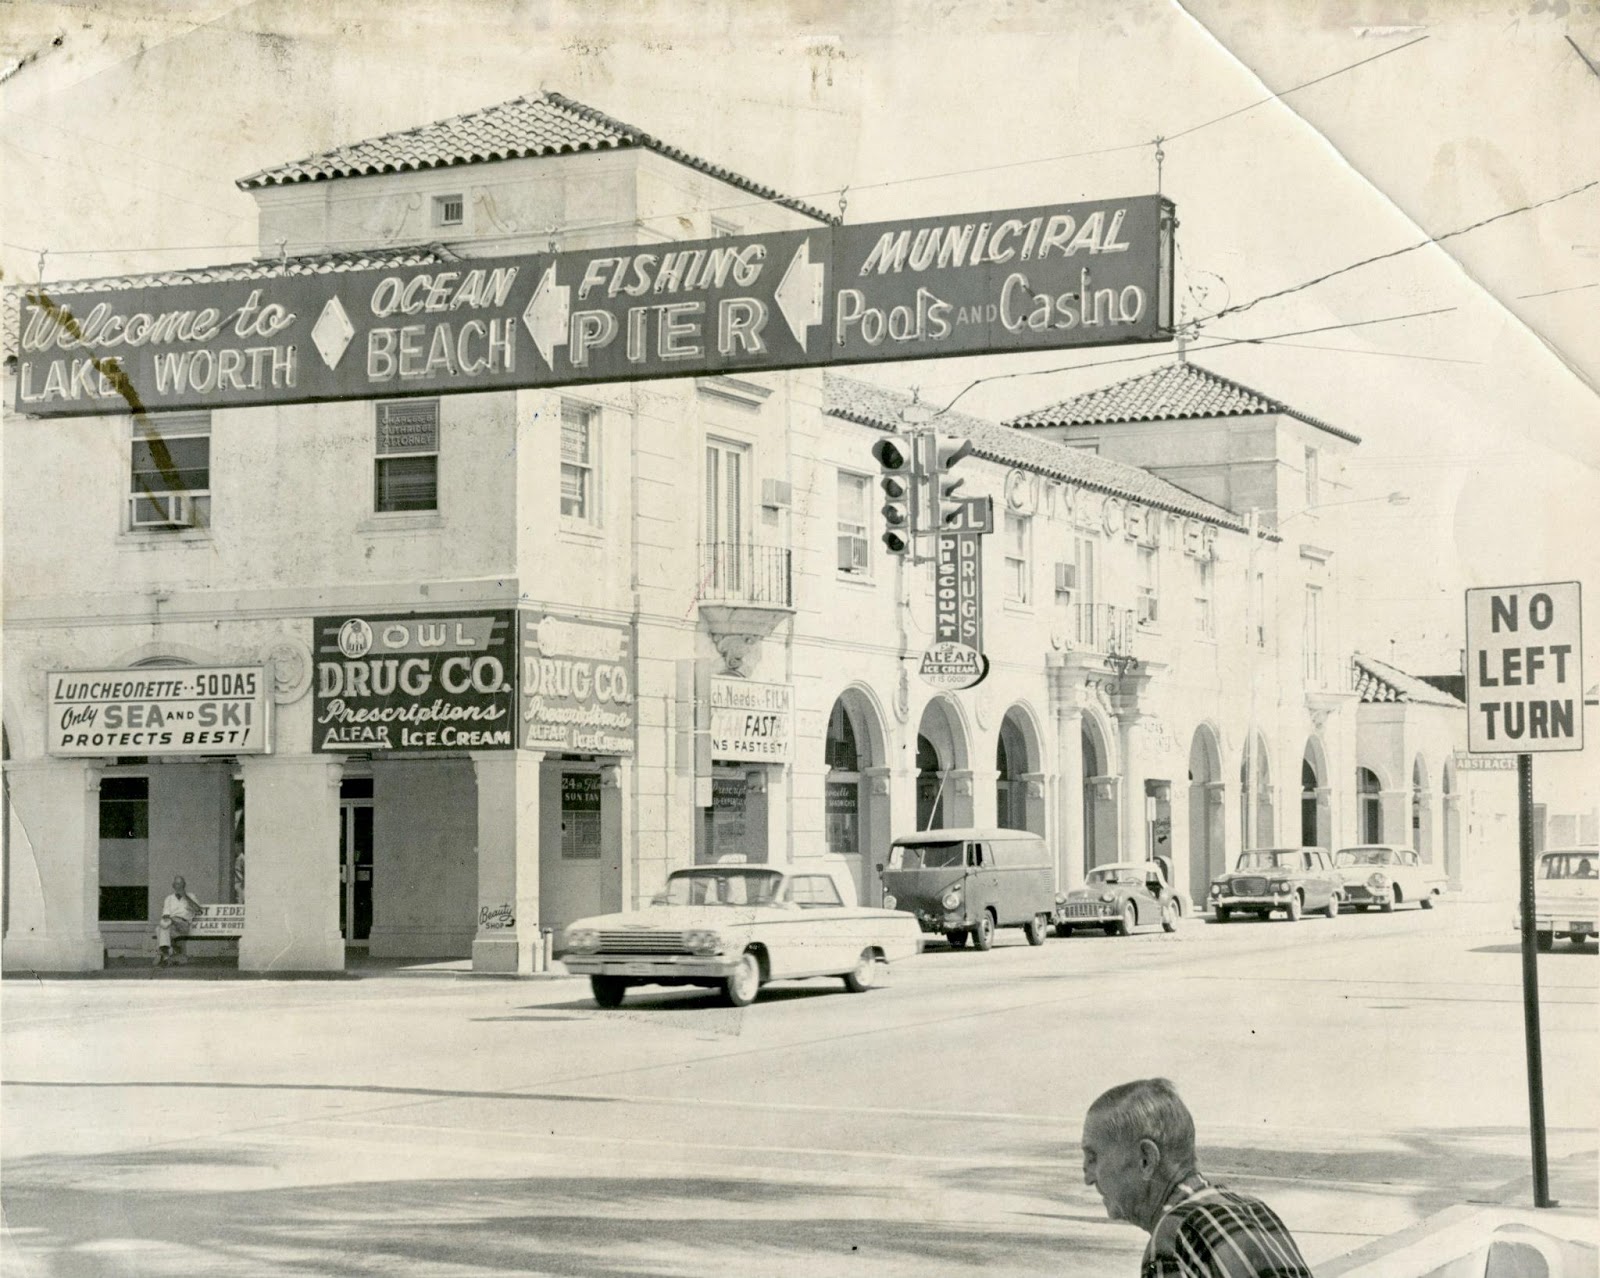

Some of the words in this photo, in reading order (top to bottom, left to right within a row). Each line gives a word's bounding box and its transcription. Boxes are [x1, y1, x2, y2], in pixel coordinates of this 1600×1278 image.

[859, 208, 1130, 277] MUNICIPAL
[370, 266, 519, 318] OCEAN
[579, 243, 768, 300] FISHING
[21, 302, 219, 353] Welcome
[231, 288, 298, 336] to
[836, 287, 953, 347] Pools
[956, 304, 998, 326] AND
[1000, 266, 1147, 335] Casino
[366, 316, 518, 383] BEACH
[568, 295, 769, 368] PIER
[20, 355, 126, 403] LAKE
[153, 345, 298, 396] WORTH
[1004, 467, 1083, 522] CITY
[1102, 495, 1219, 560] CENTER
[961, 540, 976, 637] DRUGS
[1491, 592, 1554, 634] NO
[382, 623, 476, 648] OWL
[195, 673, 256, 697] SODAS
[317, 657, 432, 699] DRUG
[440, 655, 513, 694] CO.
[523, 656, 593, 702] DRUG
[594, 664, 633, 706] CO.
[923, 665, 939, 674] ICE
[941, 665, 976, 674] CREAM
[1479, 644, 1572, 688] LEFT
[61, 704, 99, 730] Only
[103, 704, 165, 730] SEA
[166, 711, 195, 721] AND
[198, 702, 251, 728] SKI
[317, 698, 507, 726] Prescriptions
[765, 689, 790, 710] FILM
[1480, 699, 1574, 741] TURN
[61, 731, 173, 747] PROTECTS
[182, 727, 250, 746] BEST!
[401, 727, 438, 747] ICE
[441, 726, 512, 747] CREAM
[744, 714, 777, 737] FAST
[564, 791, 582, 801] SUN
[479, 903, 514, 925] Beauty
[485, 922, 504, 930] SHOP
